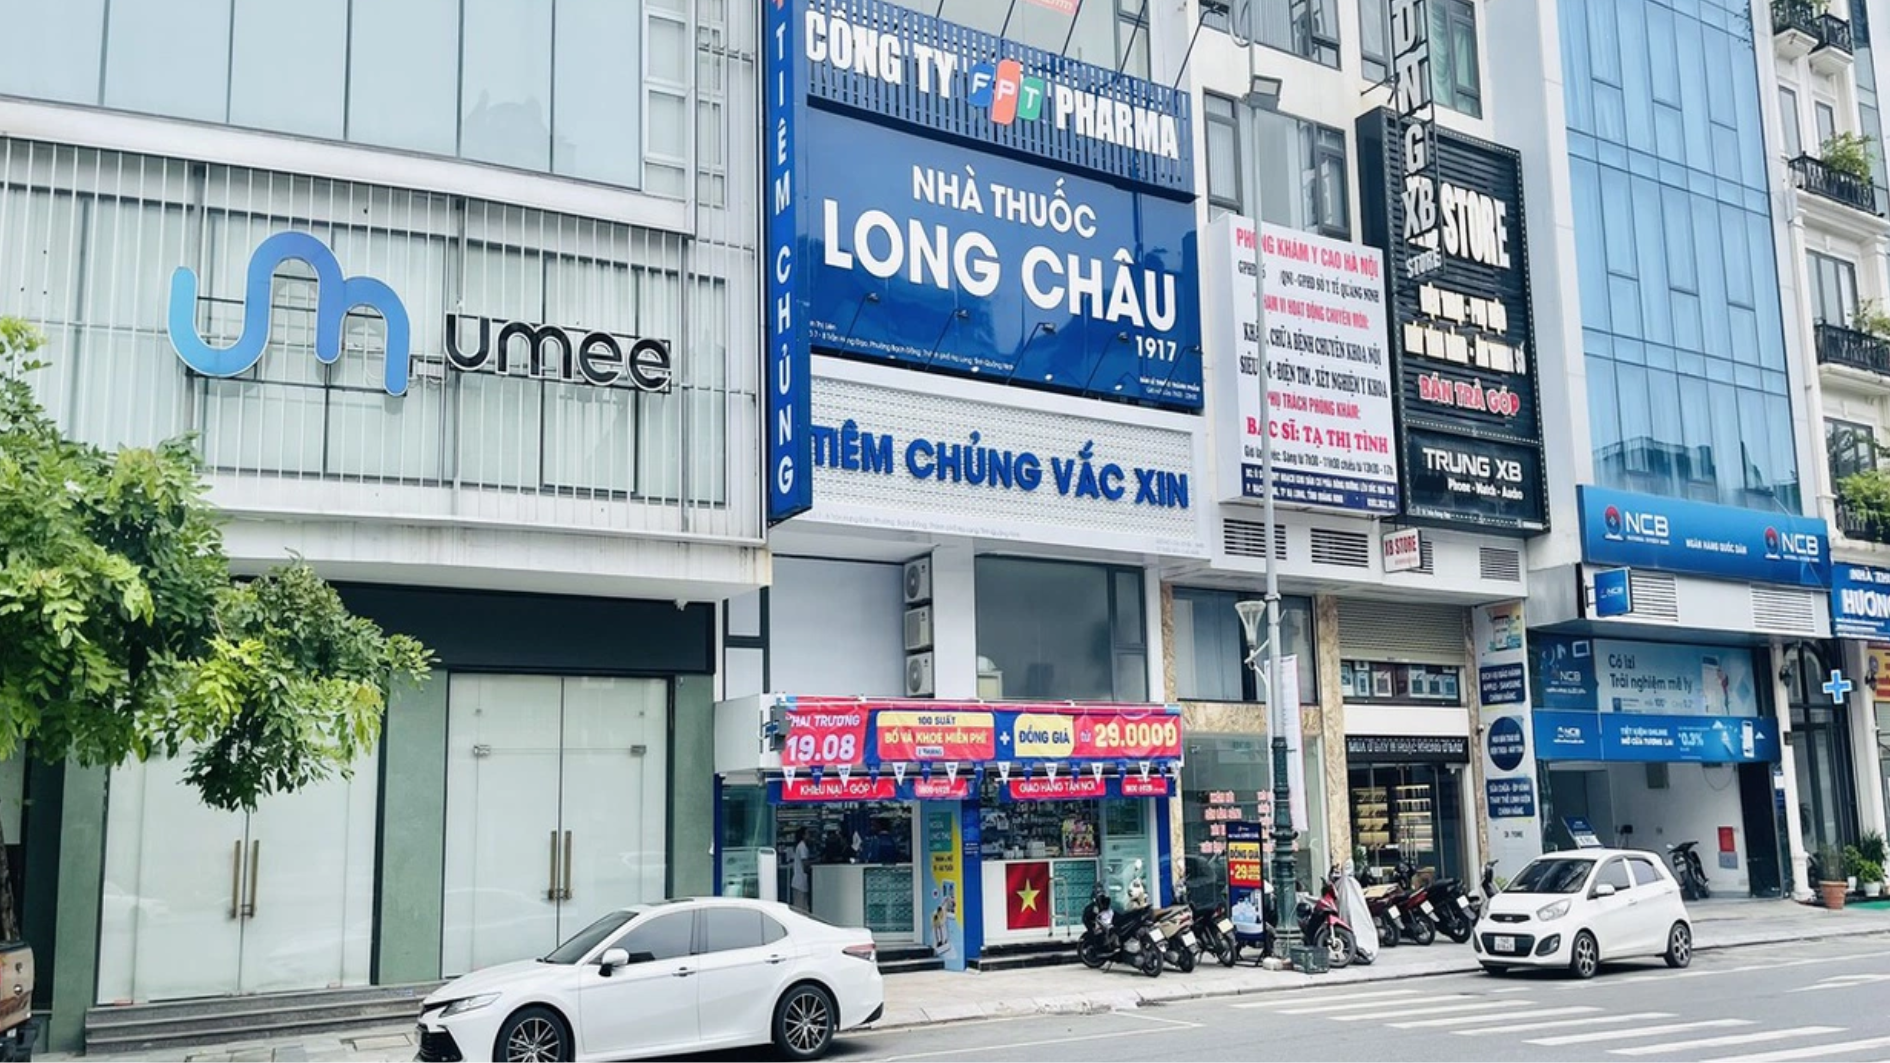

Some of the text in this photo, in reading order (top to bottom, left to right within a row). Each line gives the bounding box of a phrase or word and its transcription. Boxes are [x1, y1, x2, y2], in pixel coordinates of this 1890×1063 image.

[805, 9, 901, 86] CÔNG
[913, 43, 957, 99] TY
[1056, 85, 1180, 160] PHARMA
[912, 164, 1098, 238] NHÀ THUỐC
[1439, 183, 1511, 269] STORE
[823, 198, 1177, 332] LONG CHÂU
[1311, 245, 1317, 265] Y
[1321, 249, 1341, 271] CAO
[1344, 250, 1358, 274] HÀ
[445, 310, 673, 391] umee
[1135, 334, 1177, 363] 1917
[1419, 371, 1455, 405] BÁN
[1455, 377, 1485, 411] TRẢ
[1303, 426, 1323, 449] TẠ
[1326, 429, 1351, 453] THỊ
[1354, 430, 1388, 454] TÌNH
[811, 419, 1190, 508] TIÊM CHỦNG VẮC XIN
[1422, 447, 1522, 482] TRUNG XB
[1625, 511, 1669, 536] NCB
[1782, 533, 1818, 556] NCB
[1606, 586, 1623, 596] NCB
[1608, 653, 1622, 669] Có
[1631, 676, 1666, 694] nghiệm
[814, 714, 860, 727] TRƯƠNG
[918, 717, 932, 725] 100
[1019, 725, 1070, 744] ĐỒNG GIÁ
[786, 734, 856, 762] 19.08
[1234, 864, 1247, 881] 29
